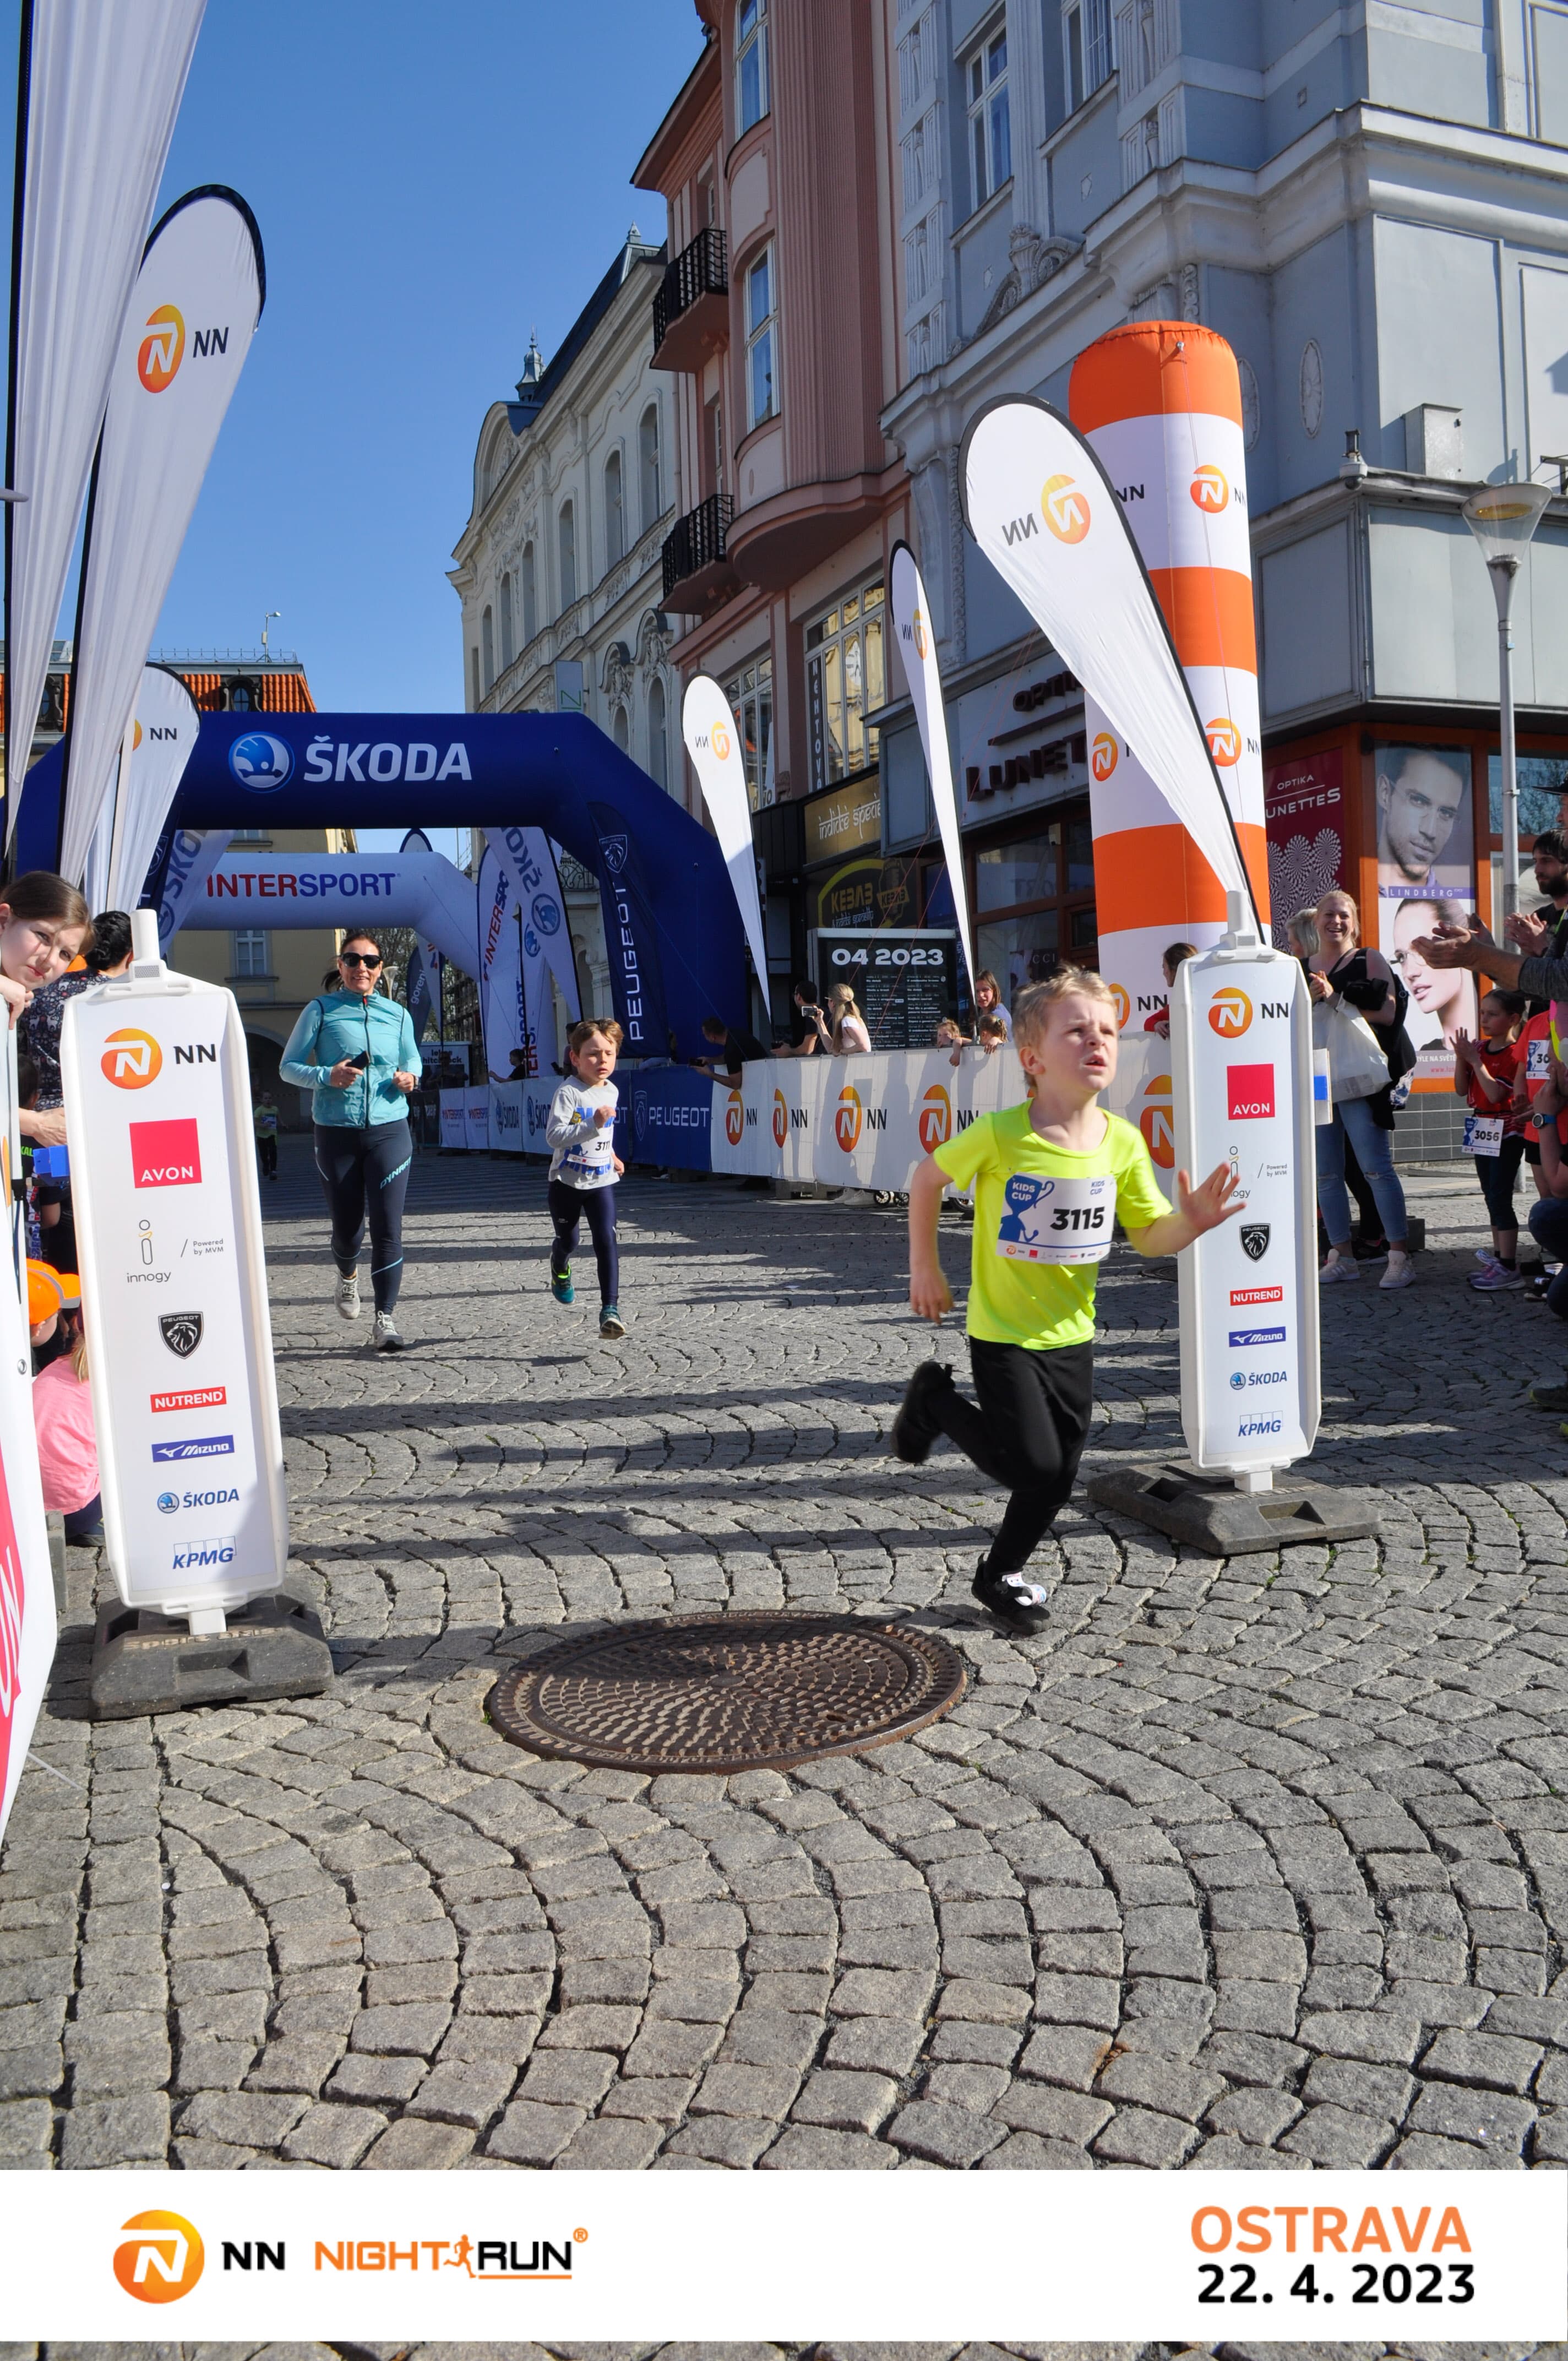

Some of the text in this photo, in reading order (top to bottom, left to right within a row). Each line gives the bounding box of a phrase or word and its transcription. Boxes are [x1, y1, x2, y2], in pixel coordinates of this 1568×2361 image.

[193, 327, 228, 358] NN
[150, 728, 177, 741] NN
[304, 735, 472, 782] ŠKODA
[1277, 774, 1314, 790] OPTIKA
[1266, 787, 1341, 819] UNETTES
[207, 872, 395, 897] INTERSPORT
[1390, 889, 1453, 897] LINDBERG
[613, 882, 644, 1040] PEUGEOT
[831, 948, 868, 966] 04
[875, 948, 944, 966] 2023
[1137, 994, 1168, 1011] NN
[1261, 1002, 1289, 1019] NN
[175, 1043, 216, 1064] NN
[649, 1107, 709, 1127] PEUGEOT
[747, 1108, 758, 1126] NN
[1233, 1103, 1271, 1115] AVON
[791, 1109, 808, 1128] NN
[867, 1109, 887, 1130] NN
[1474, 1130, 1500, 1141] 3056
[141, 1165, 193, 1182] AVON
[1012, 1182, 1036, 1193] KIDS
[1011, 1192, 1032, 1201] CUP
[1050, 1206, 1105, 1231] 3115
[193, 1238, 224, 1247] Powered
[193, 1248, 203, 1256] by
[127, 1272, 171, 1283] innogy
[1233, 1289, 1280, 1303] NUTREND
[162, 1315, 199, 1323] PEUGEOT
[1248, 1371, 1287, 1386] ŠKODA
[155, 1390, 223, 1408] NUTREND
[1238, 1419, 1281, 1437] KPMG
[183, 1488, 240, 1508] ŠKODA
[172, 1547, 235, 1569] KPMG
